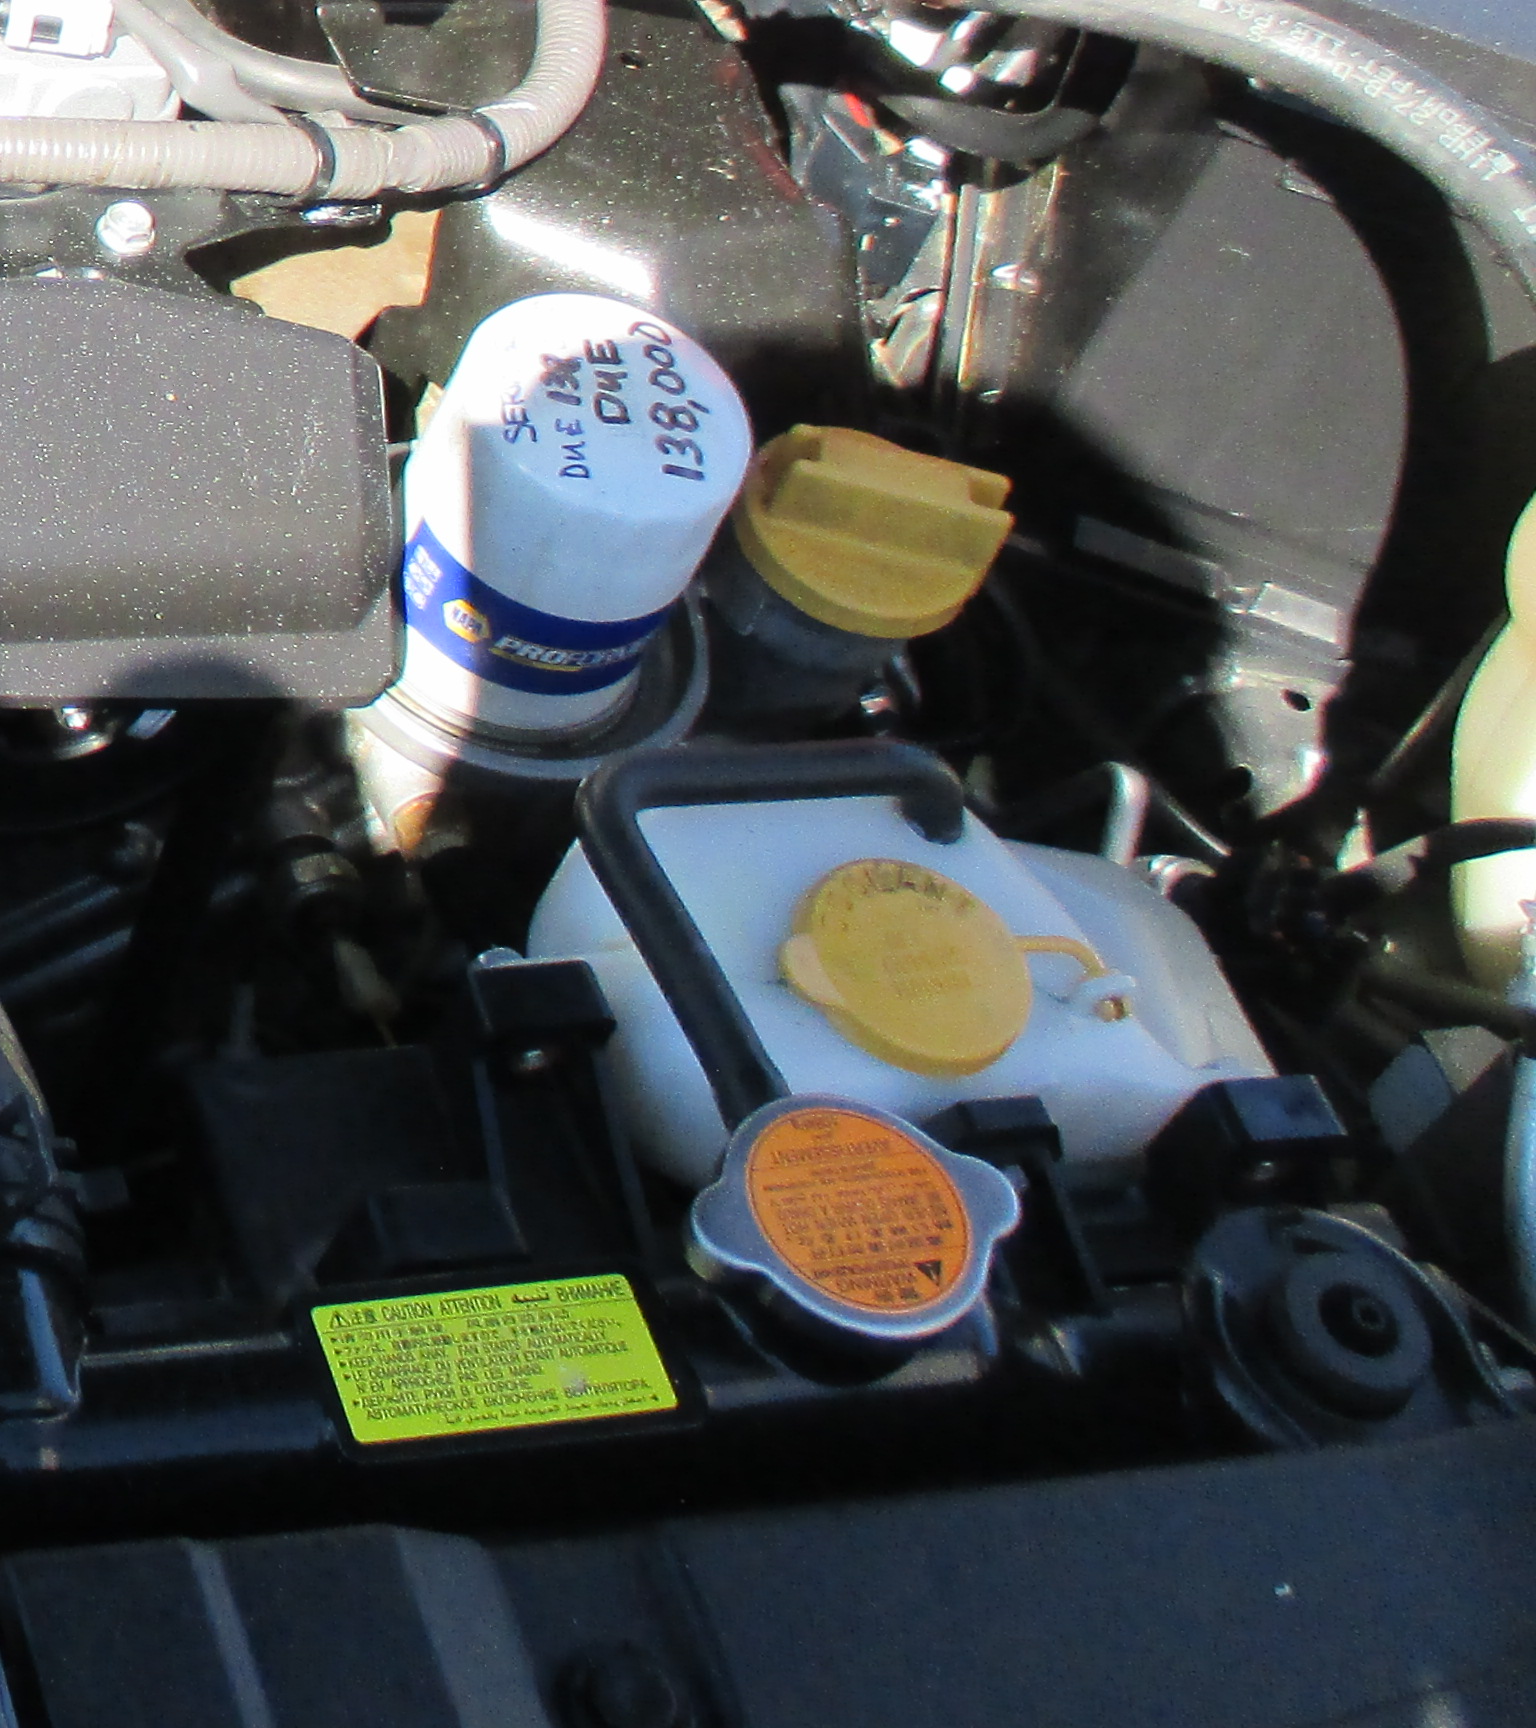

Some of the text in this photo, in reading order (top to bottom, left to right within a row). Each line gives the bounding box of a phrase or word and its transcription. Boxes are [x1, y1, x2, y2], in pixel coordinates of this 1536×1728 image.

[583, 338, 631, 425] DUE
[628, 321, 711, 481] 138,000
[555, 418, 590, 479] DUE
[379, 1301, 434, 1321] CAUTION
[437, 1293, 502, 1314] ATTENTION
[554, 1280, 625, 1302] ВНИМАНИЕ
[836, 1269, 915, 1293] WARNING
